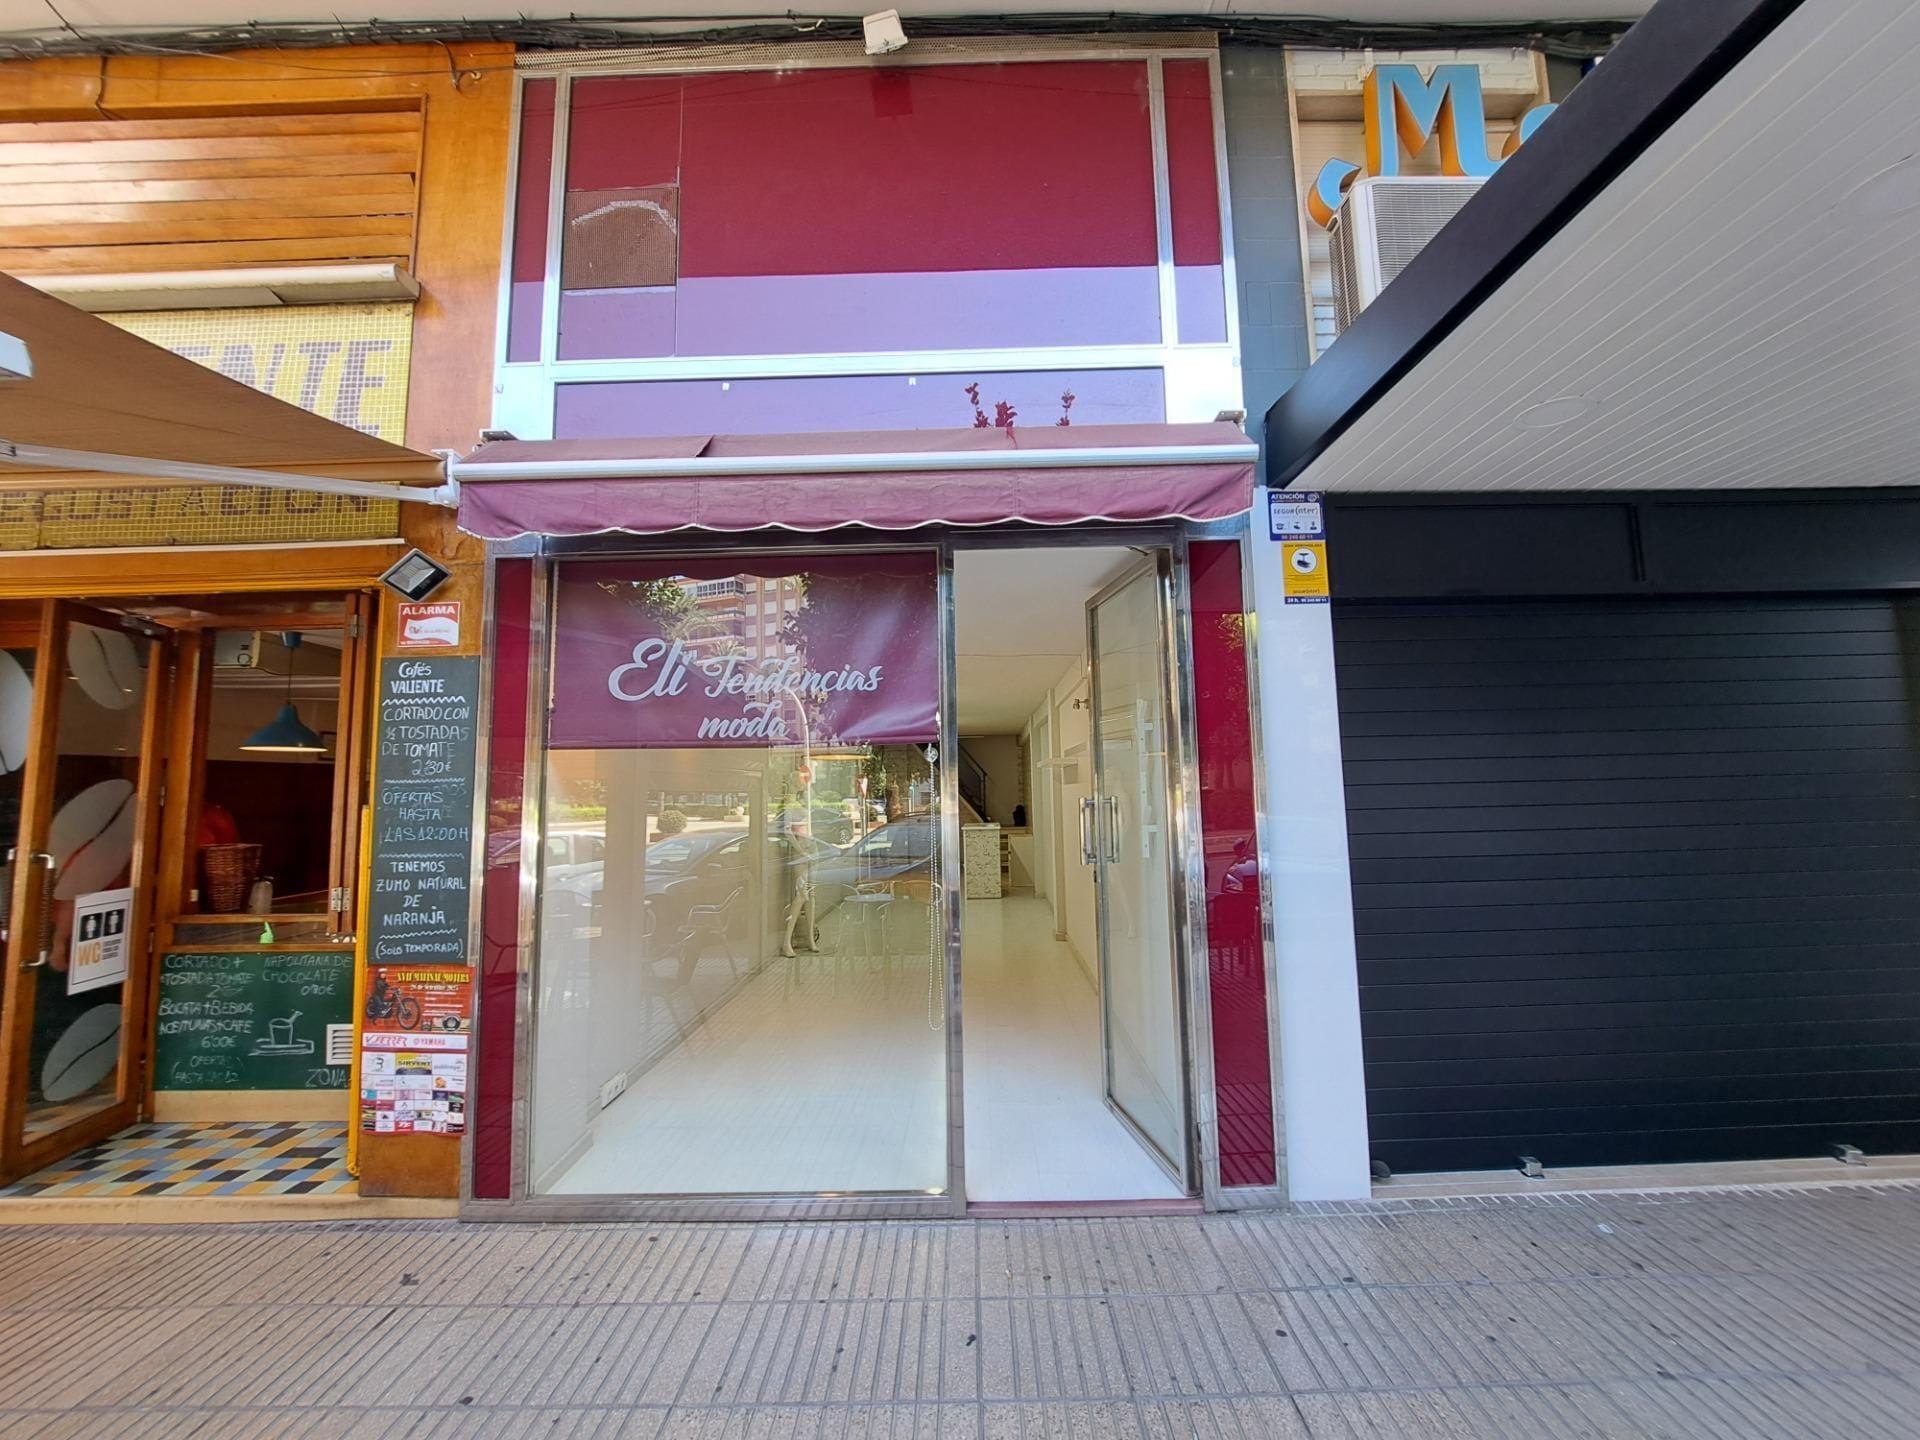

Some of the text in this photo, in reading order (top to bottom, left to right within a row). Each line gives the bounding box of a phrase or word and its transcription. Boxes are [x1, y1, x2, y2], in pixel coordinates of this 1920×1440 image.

[402, 605, 456, 616] ALARMA
[398, 661, 432, 678] Cafés
[608, 637, 884, 702] Eli Tendencias
[390, 678, 445, 694] VALIENTE
[383, 705, 471, 722] CORTADO CON
[697, 700, 791, 740] moda
[399, 724, 471, 742] TOSTADAS
[382, 741, 457, 759] DE TOMATE
[382, 791, 445, 806] OFERTAS
[399, 807, 442, 822] HASTA
[383, 826, 417, 843] LAS
[390, 860, 446, 873] TENEMOS
[376, 876, 467, 893] ZUMO NATURAL
[402, 894, 423, 908] DE
[78, 941, 102, 967] WC
[165, 954, 231, 970] CORTADO
[333, 955, 354, 968] DE
[262, 968, 342, 984] CHOCOLATE
